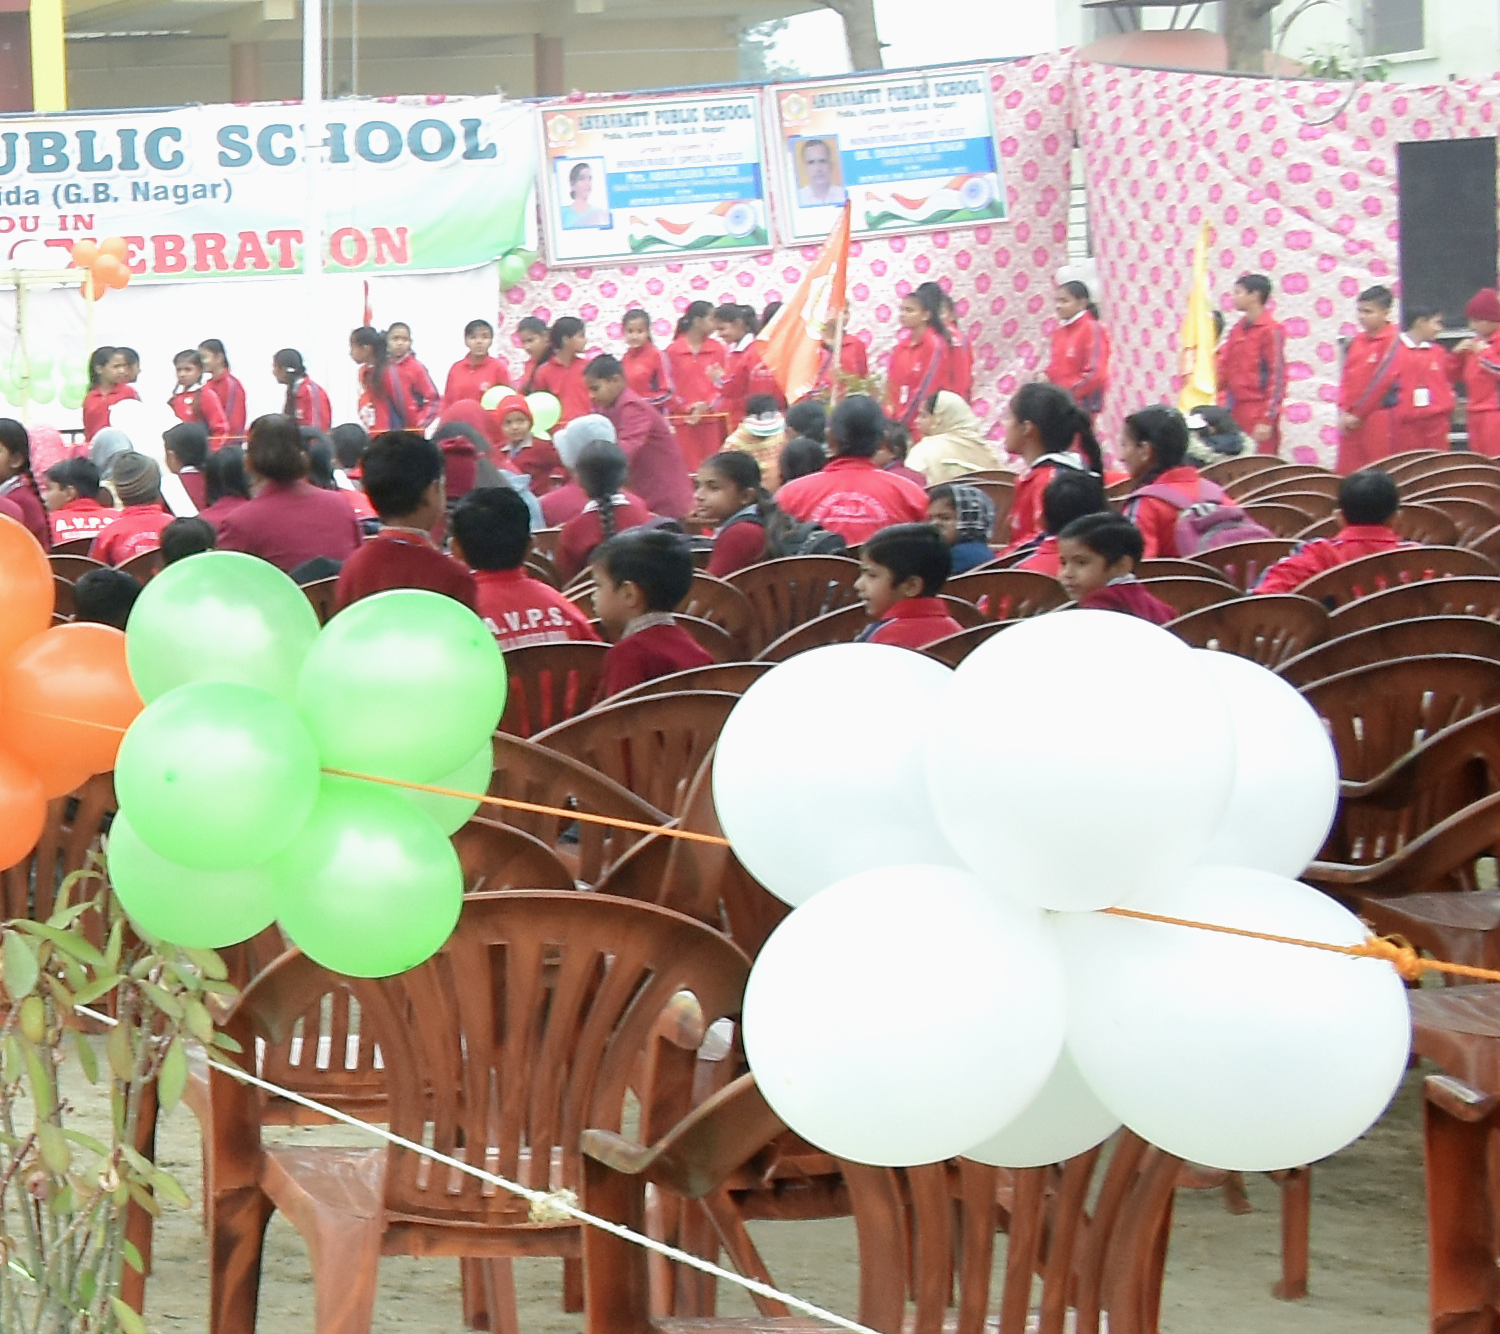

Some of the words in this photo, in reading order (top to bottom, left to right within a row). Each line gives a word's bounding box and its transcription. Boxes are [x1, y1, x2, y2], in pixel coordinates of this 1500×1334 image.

[216, 117, 498, 168] SCHOOL
[51, 182, 119, 210] (G.B.
[131, 177, 234, 206] Nagar)
[58, 213, 95, 232] IN
[8, 226, 409, 275] EBRATON
